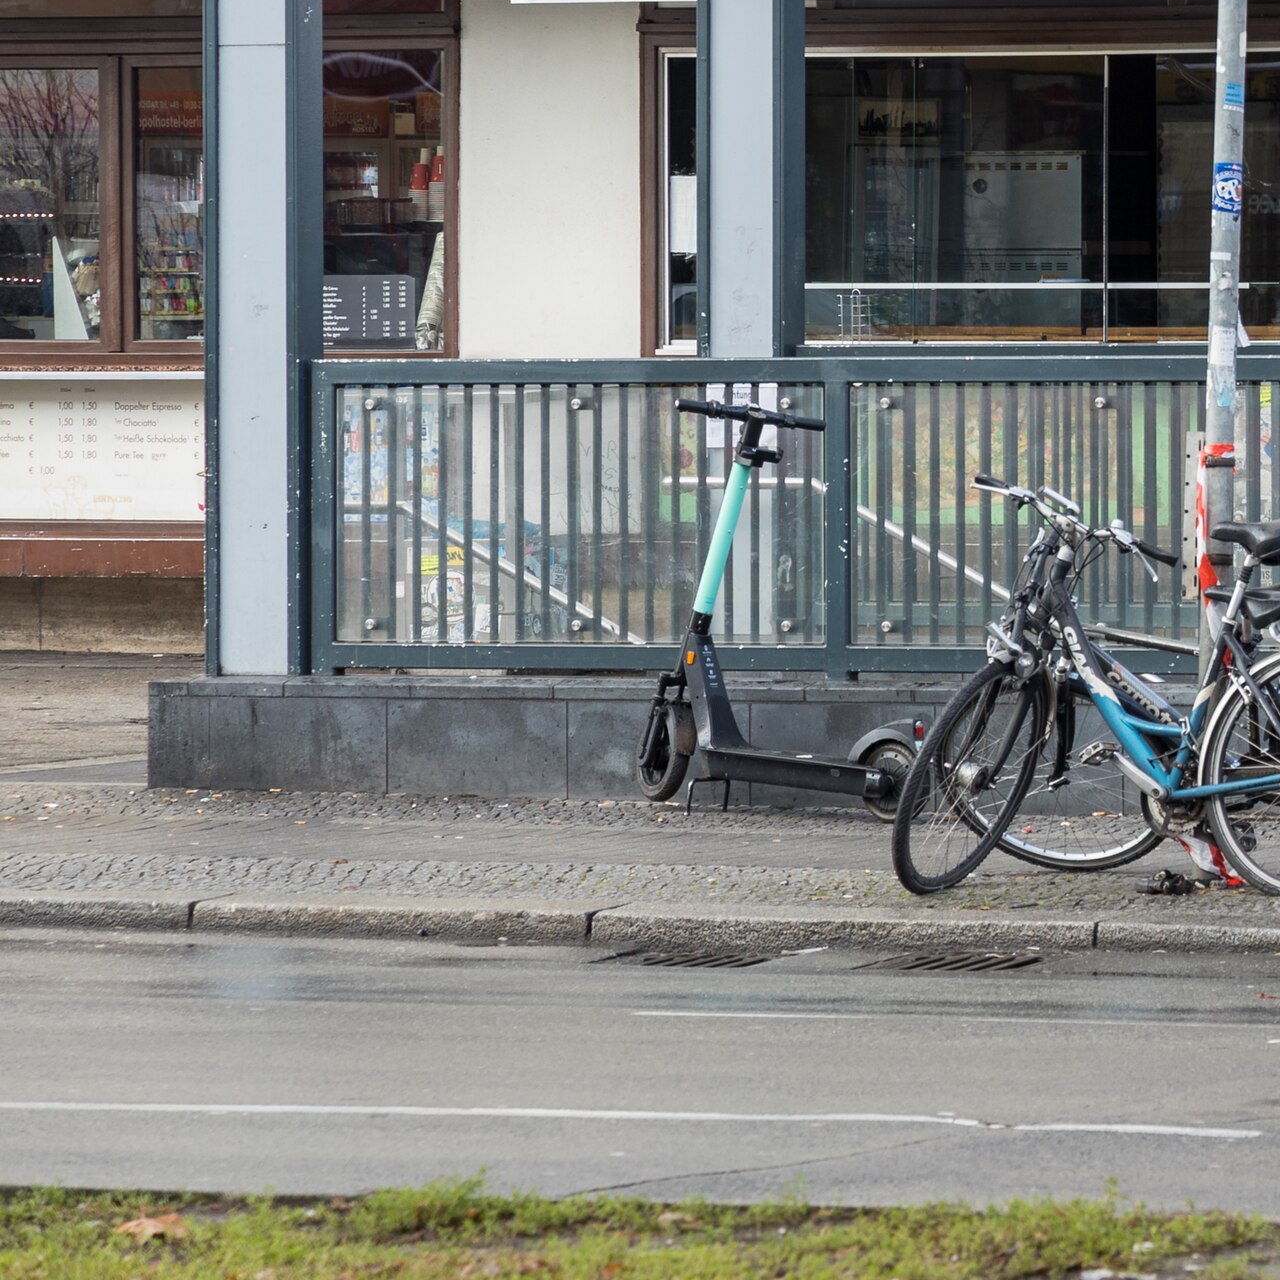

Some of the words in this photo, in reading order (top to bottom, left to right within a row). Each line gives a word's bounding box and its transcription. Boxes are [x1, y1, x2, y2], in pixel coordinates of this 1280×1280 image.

[58, 402, 73, 410] 1,00
[82, 402, 97, 410] 1,50
[114, 402, 150, 411] Doppelter
[152, 402, 182, 411] Espresso
[132, 451, 144, 459] Tee
